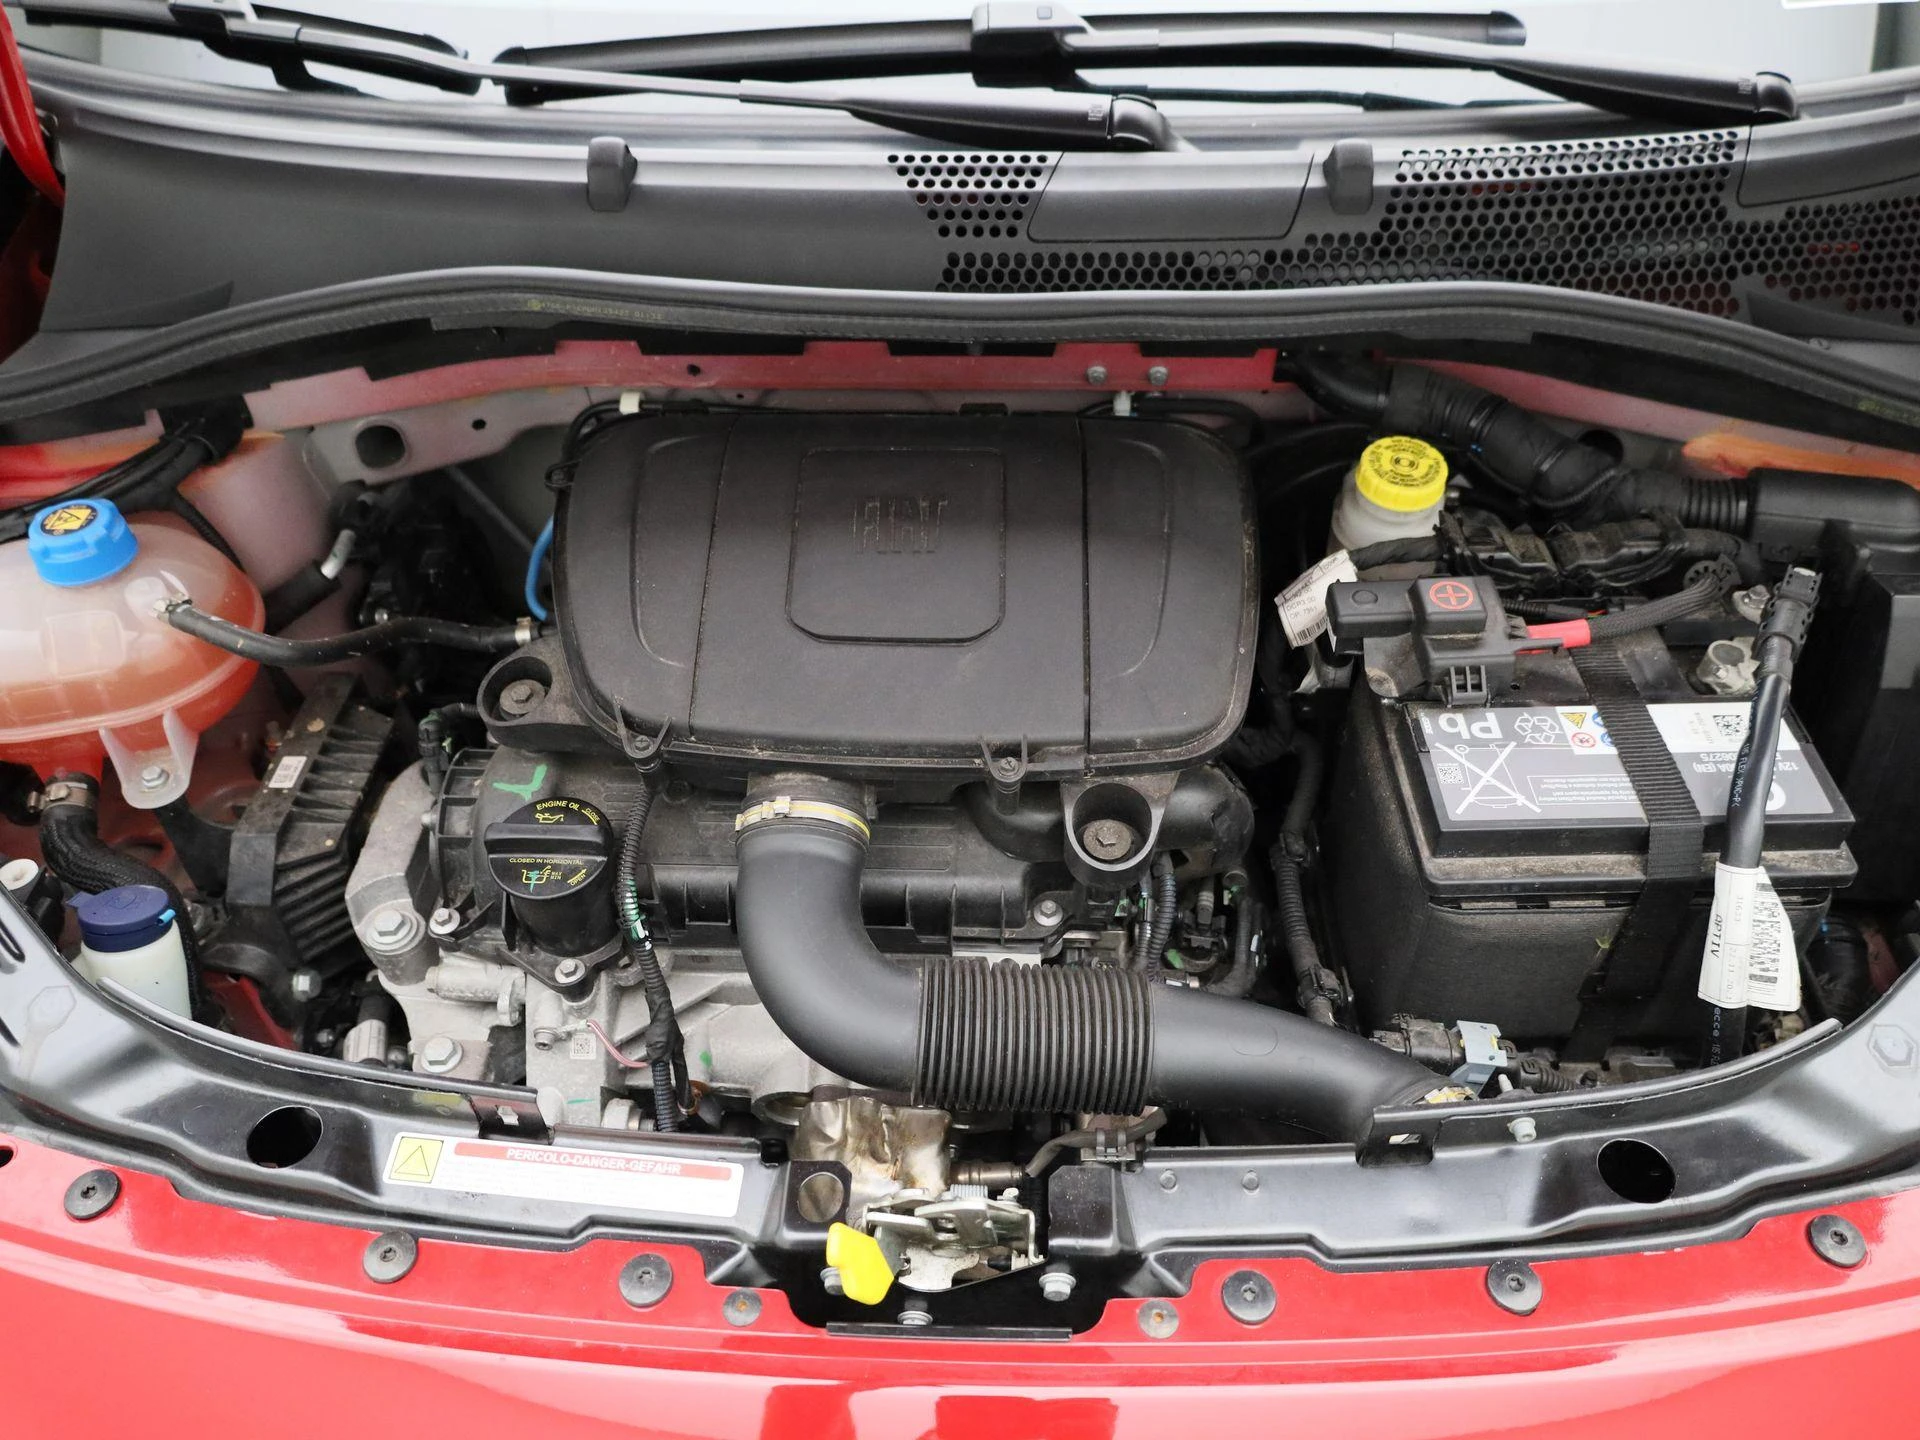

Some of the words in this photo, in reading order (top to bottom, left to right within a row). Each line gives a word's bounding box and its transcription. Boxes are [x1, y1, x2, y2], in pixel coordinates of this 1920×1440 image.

[1438, 712, 1503, 739] Pb
[536, 801, 568, 811] ENGINE
[568, 803, 580, 811] OIL
[585, 807, 600, 822] CLOSE
[570, 873, 587, 886] OPEN
[1710, 914, 1723, 959] APTIV
[506, 1148, 682, 1175] PERICOLO-DANGER-GEFAHR
